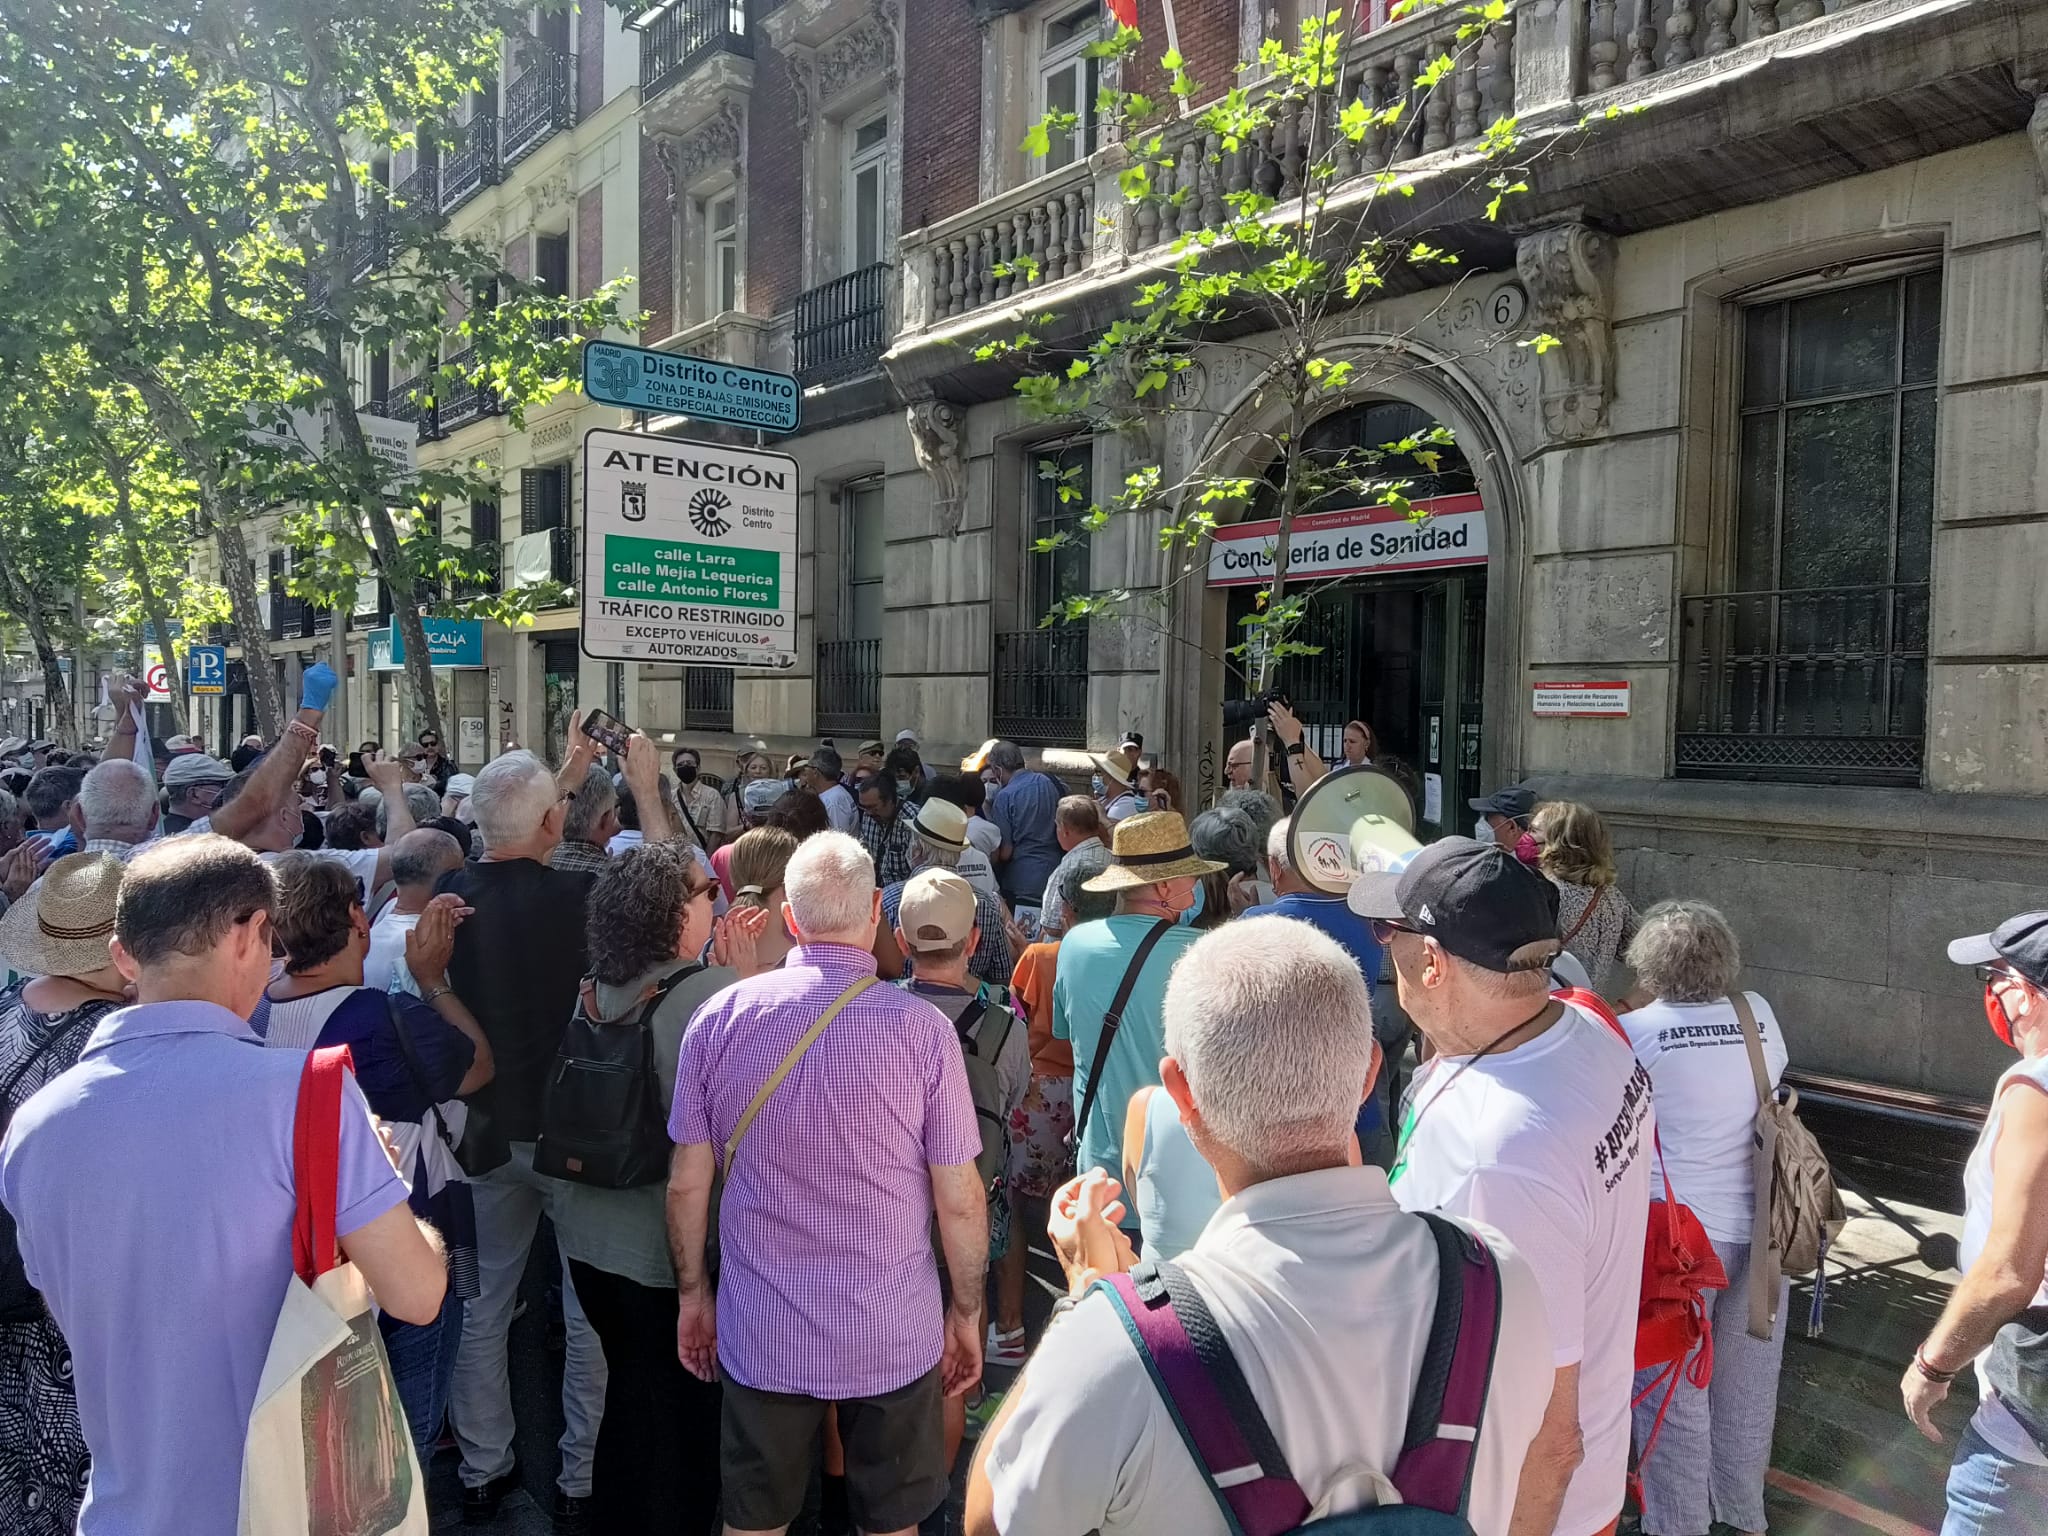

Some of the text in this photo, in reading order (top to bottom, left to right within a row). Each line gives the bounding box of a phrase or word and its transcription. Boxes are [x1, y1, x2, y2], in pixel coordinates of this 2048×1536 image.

[1494, 294, 1510, 324] 6
[594, 346, 621, 359] MADRID
[594, 357, 639, 400] 360
[643, 356, 793, 398] Distrito Centro
[645, 380, 791, 414] ZONA DE BAJAS EMISIONES
[647, 393, 789, 426] DE ESPECIAL PROTECCIÓN
[603, 450, 785, 490] ATENCIÓN
[742, 505, 775, 518] Distrito
[1311, 513, 1371, 527] Comunidad de Madrid
[742, 518, 773, 530] Centro
[654, 549, 736, 566] calle Larra
[1223, 523, 1468, 570] Consería de Sanidad
[612, 562, 774, 586] calle Mejía Lequerica
[617, 579, 768, 602] calle Antonio Flores
[599, 600, 785, 628] TRÁFICO RESTRINGIDO
[626, 625, 686, 640] EXCEPTO
[689, 629, 759, 644] VEHÍCULOS
[648, 643, 738, 658] AUTORIZADOS
[198, 652, 219, 679] P
[1597, 700, 1624, 708] Laborales
[470, 721, 483, 731] 50
[1689, 1040, 1719, 1049] Urgencias
